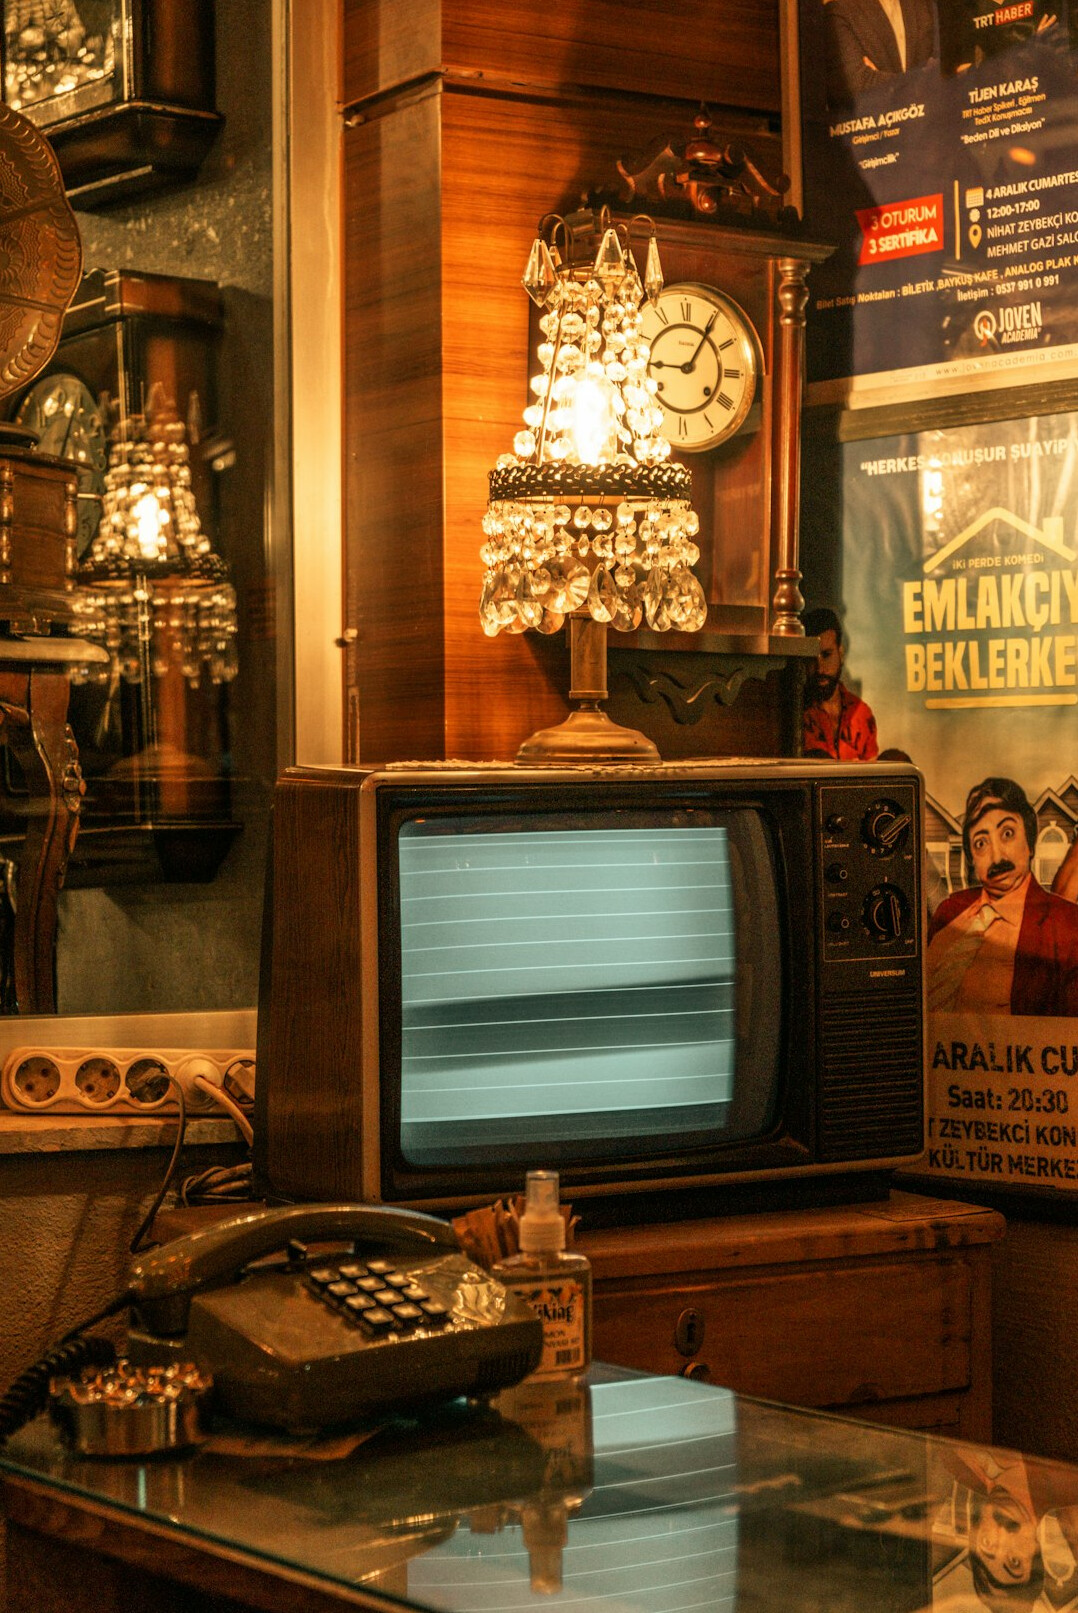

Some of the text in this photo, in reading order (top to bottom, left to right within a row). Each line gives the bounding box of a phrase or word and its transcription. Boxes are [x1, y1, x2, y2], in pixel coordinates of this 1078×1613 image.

[973, 3, 1033, 29] TRT HABER
[969, 76, 1039, 104] TİJEN KARAŞ
[830, 103, 926, 138] MUSTAFA AÇIKGÖZ
[1000, 127, 1011, 136] ve
[986, 188, 994, 199] 4
[993, 179, 1028, 200] ARALIK
[871, 204, 938, 231] 3 OTURUM
[986, 199, 1040, 219] 12:00-17:00
[869, 227, 939, 255] 3 SERTİFİKA
[986, 221, 1017, 239] NİHAT
[986, 240, 1030, 259] MEHMET
[1031, 233, 1055, 251] GAZİ
[901, 279, 935, 297] BİLETİX
[974, 268, 998, 284] KAFE
[1004, 258, 1044, 278] ANALOG
[1045, 256, 1071, 270] PLAK
[996, 279, 1016, 295] 0537
[1017, 277, 1034, 292] 991
[1035, 276, 1042, 288] 0
[1043, 273, 1060, 287] 991
[999, 301, 1042, 333] JOVEN
[968, 556, 1001, 568] PERDE
[905, 636, 1077, 692] BEKLERKE
[932, 1040, 1035, 1075] ARALIK
[948, 1085, 1069, 1114] Saat: 20:30
[1036, 1125, 1077, 1147] KON
[929, 1143, 1003, 1173] KÜLTÜR
[534, 1303, 575, 1323] iking
